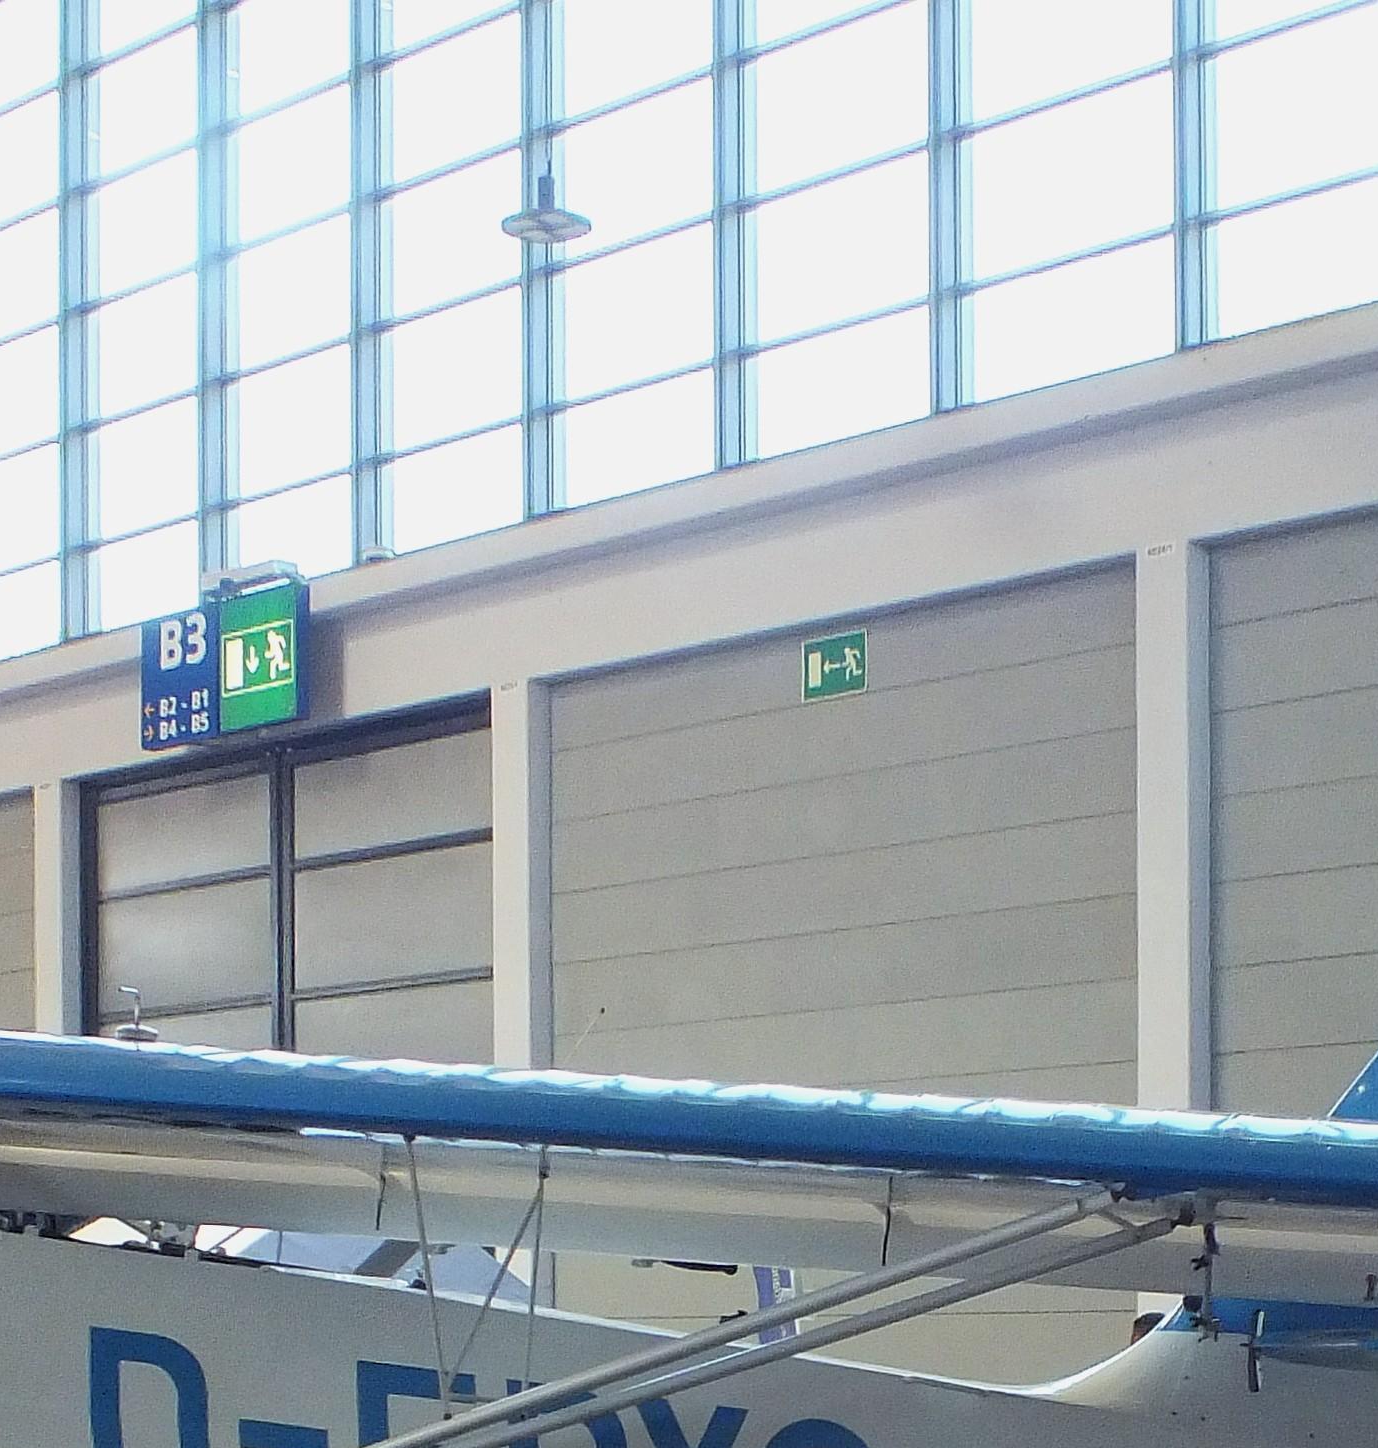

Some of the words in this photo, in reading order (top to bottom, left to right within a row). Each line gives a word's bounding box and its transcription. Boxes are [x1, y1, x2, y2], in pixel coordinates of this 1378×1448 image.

[159, 612, 207, 670] B3
[160, 697, 176, 717] B2
[192, 688, 208, 710] B1
[159, 719, 177, 740] B4
[192, 712, 209, 733] B5
